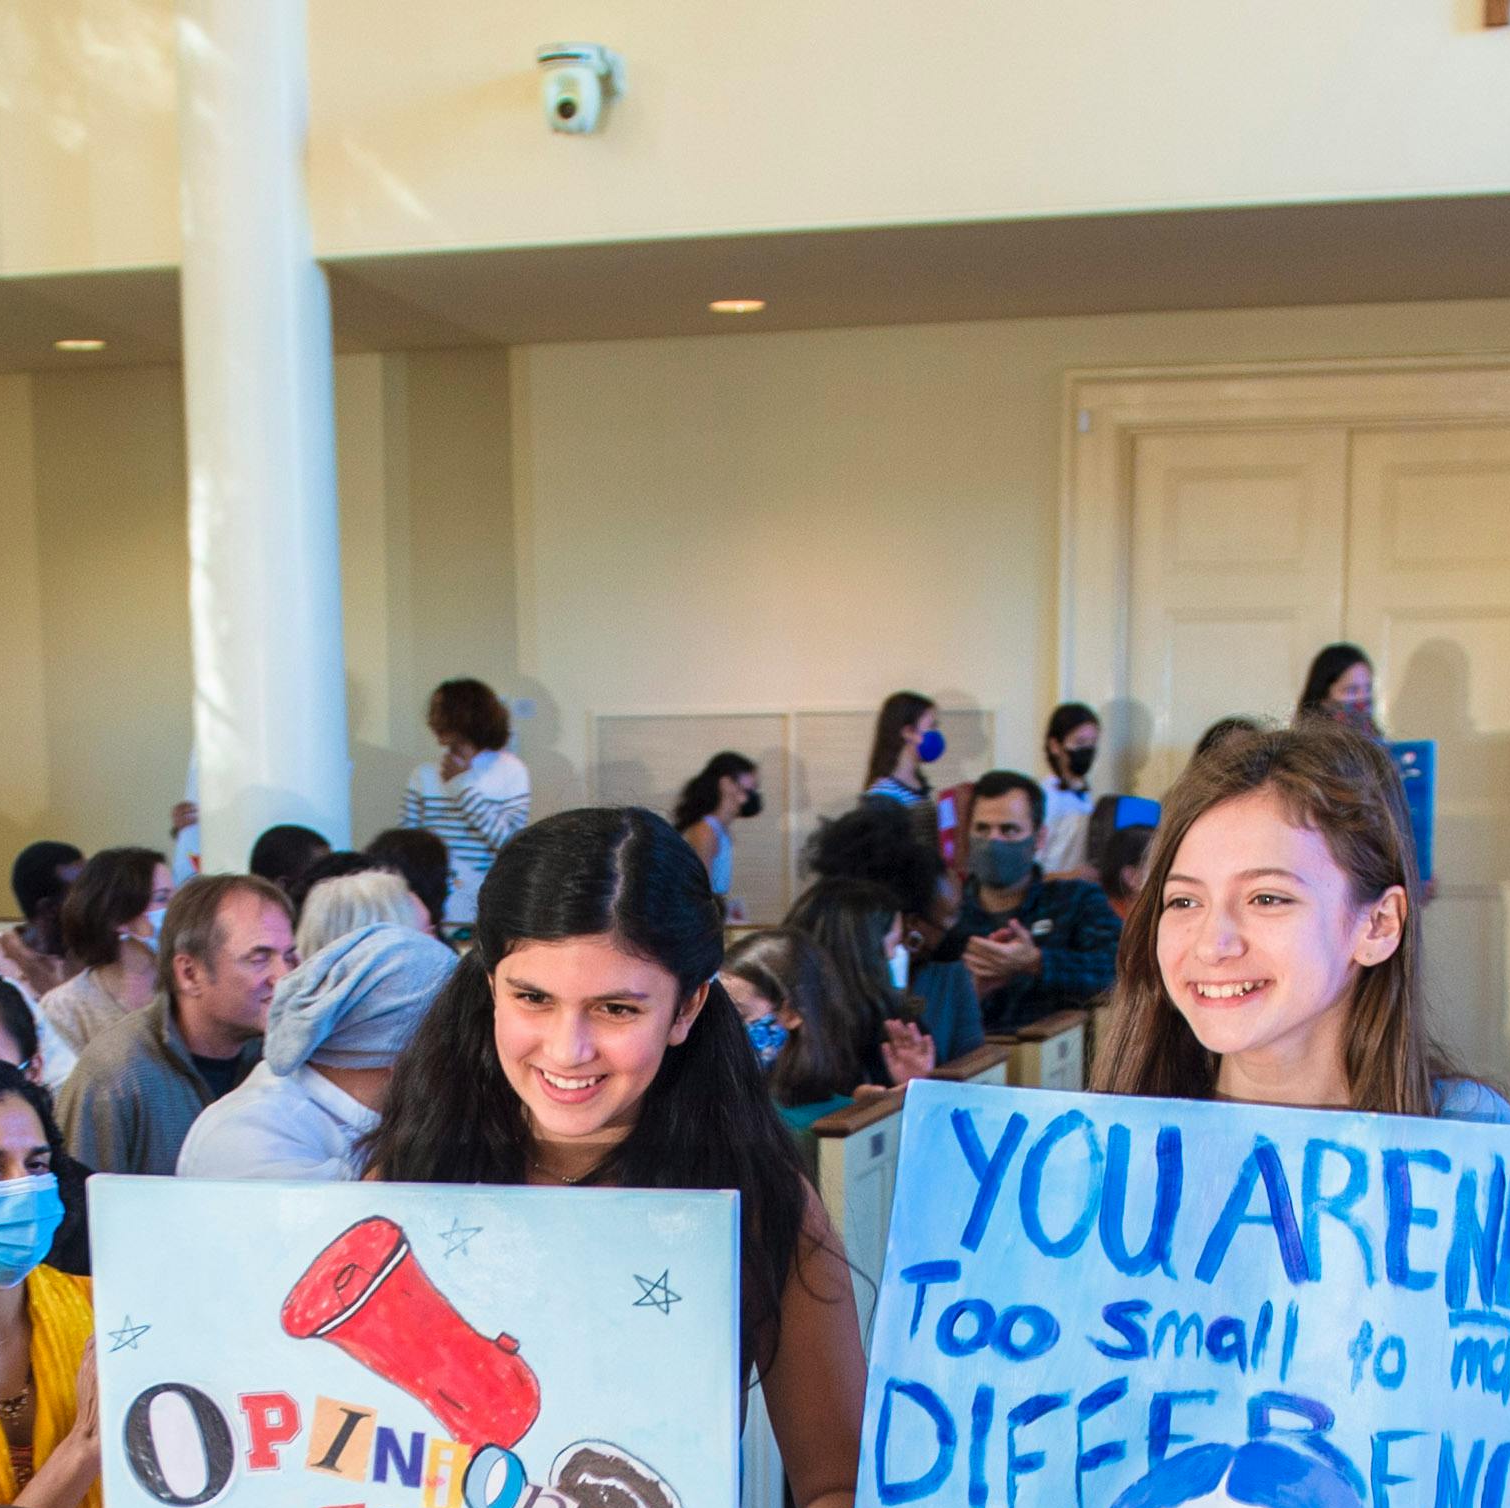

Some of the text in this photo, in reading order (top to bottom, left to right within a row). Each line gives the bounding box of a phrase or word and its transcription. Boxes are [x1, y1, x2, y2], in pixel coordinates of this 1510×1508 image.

[950, 1108, 1182, 1280] YOU
[1194, 1134, 1451, 1291] ARE
[1349, 1320, 1406, 1392] to
